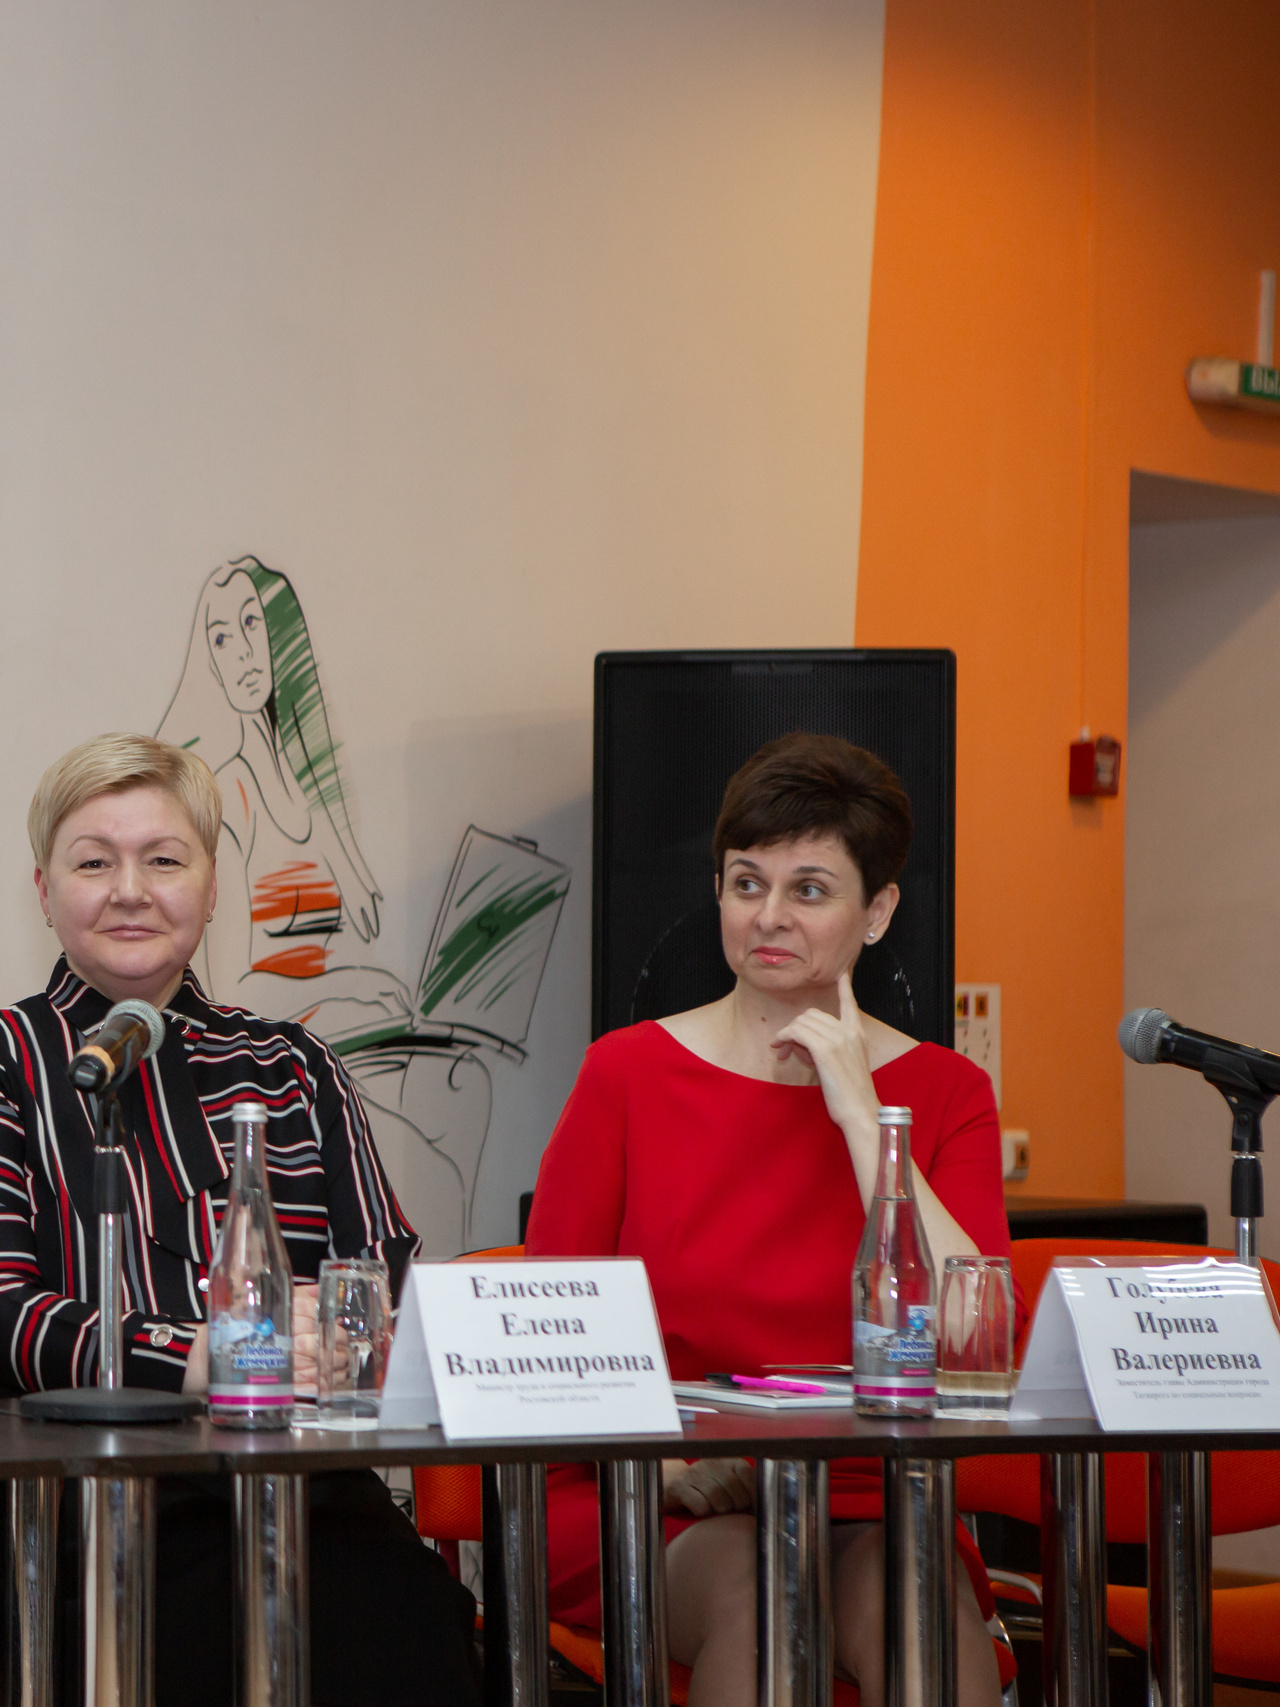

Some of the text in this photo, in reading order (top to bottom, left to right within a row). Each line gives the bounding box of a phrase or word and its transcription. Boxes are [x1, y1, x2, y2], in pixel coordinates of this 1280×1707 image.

[469, 1275, 600, 1300] Елисеева
[499, 1311, 587, 1337] Елена
[1134, 1310, 1220, 1340] Ирина
[444, 1352, 656, 1378] Владимировна
[1111, 1346, 1263, 1376] Валериевна
